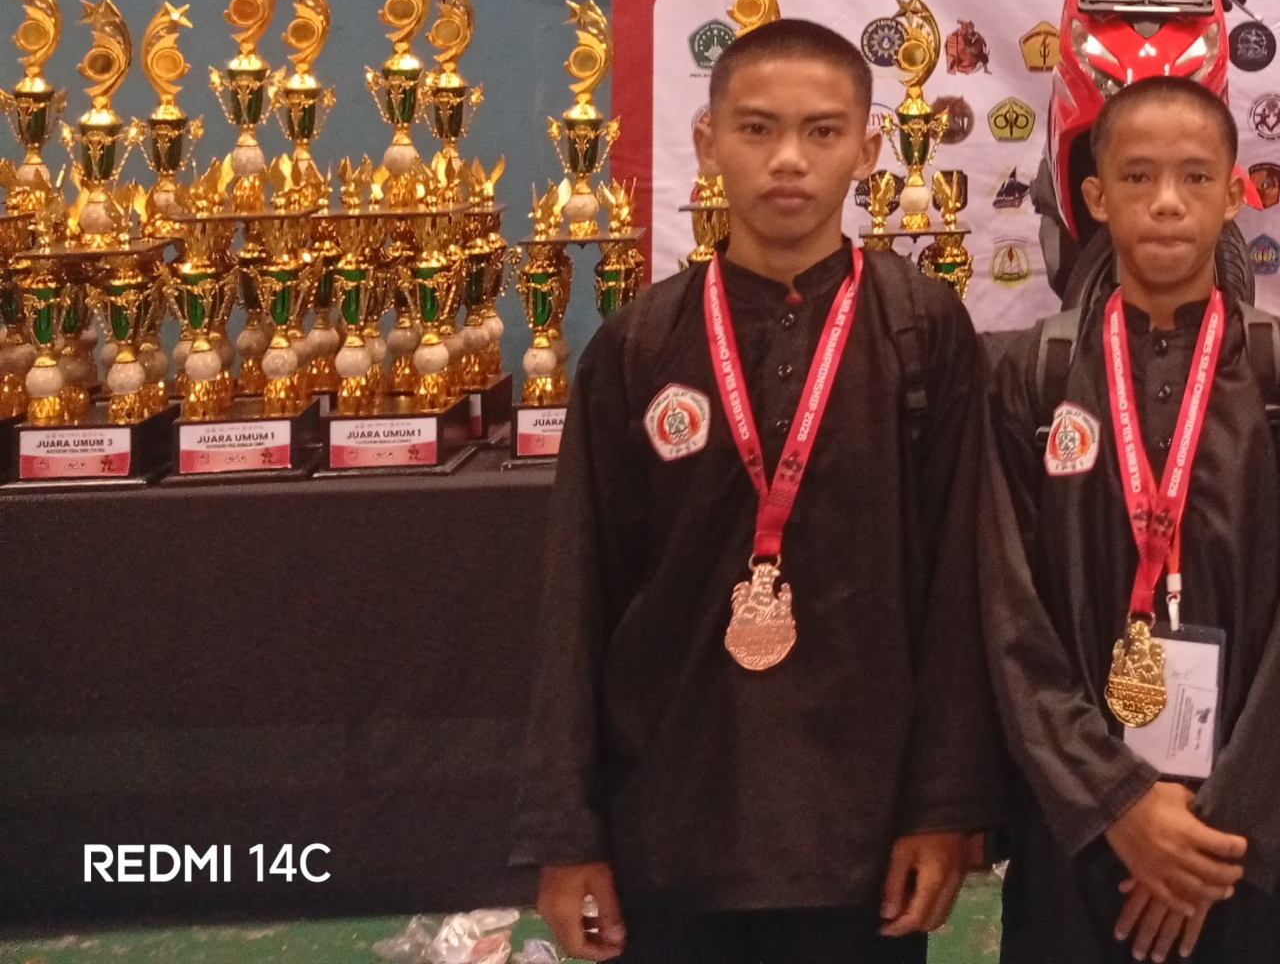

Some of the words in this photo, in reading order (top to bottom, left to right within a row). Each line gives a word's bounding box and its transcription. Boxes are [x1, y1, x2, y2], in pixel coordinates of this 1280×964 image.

[709, 284, 730, 360] CHAMPIONSHIP
[721, 360, 737, 391] SILAT
[808, 326, 842, 411] CHAMPIONSHIP
[1110, 334, 1128, 410] CHAMPIONSHIP
[1196, 355, 1210, 385] SILAT
[532, 418, 565, 427] JUARA
[729, 390, 750, 440] CELEBES
[796, 411, 815, 442] 2026
[1120, 412, 1133, 443] SILAT
[1177, 383, 1203, 467] CHAMPIONSHIP
[36, 439, 70, 448] JUARA
[73, 439, 104, 447] UMUM
[107, 438, 113, 447] 3
[197, 435, 233, 444] JUARA
[234, 432, 268, 442] UMUM
[346, 430, 380, 440] JUARA
[382, 429, 416, 438] UMUM
[1125, 443, 1141, 493] CELEBES
[1167, 467, 1183, 498] 2026
